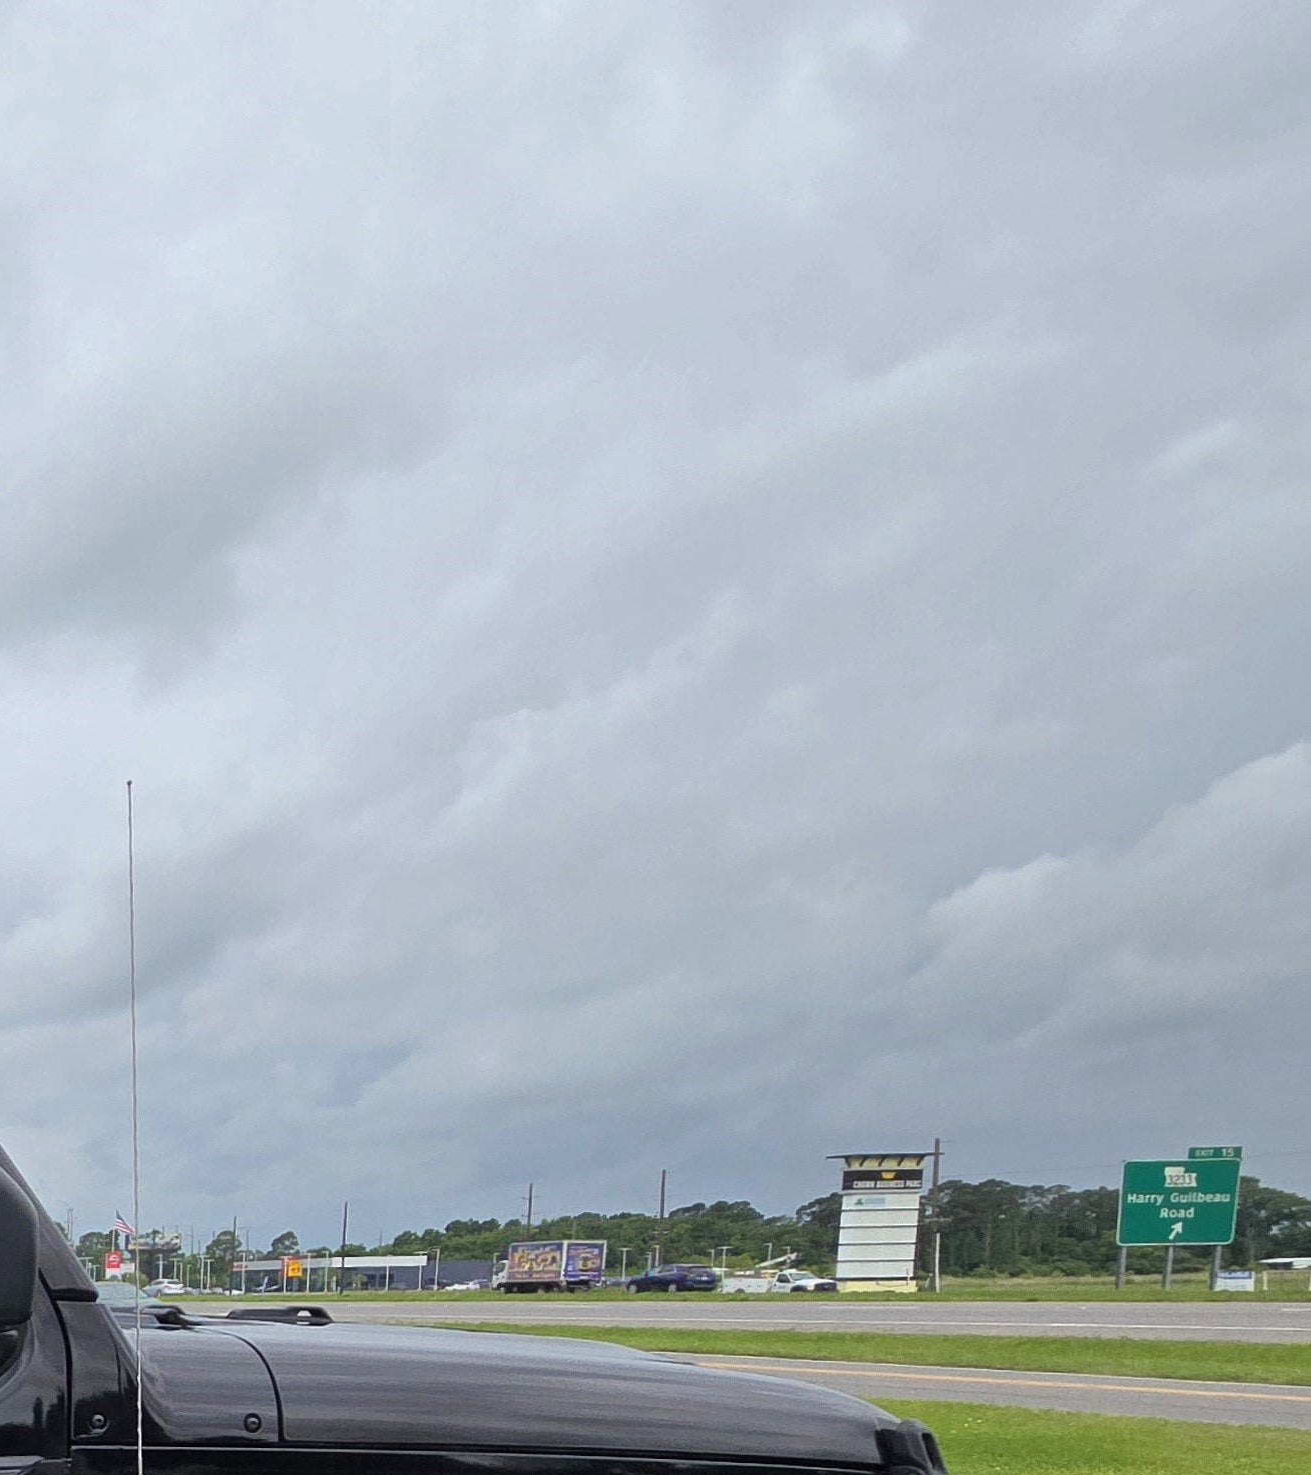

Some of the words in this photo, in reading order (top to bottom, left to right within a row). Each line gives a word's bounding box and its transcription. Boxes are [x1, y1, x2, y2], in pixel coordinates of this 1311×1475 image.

[1194, 1149, 1214, 1157] EXIT
[1221, 1147, 1235, 1157] 15
[1167, 1174, 1193, 1185] 3233
[1127, 1193, 1164, 1206] Harry
[1170, 1192, 1231, 1203] Guilbeau
[1159, 1206, 1195, 1218] Road
